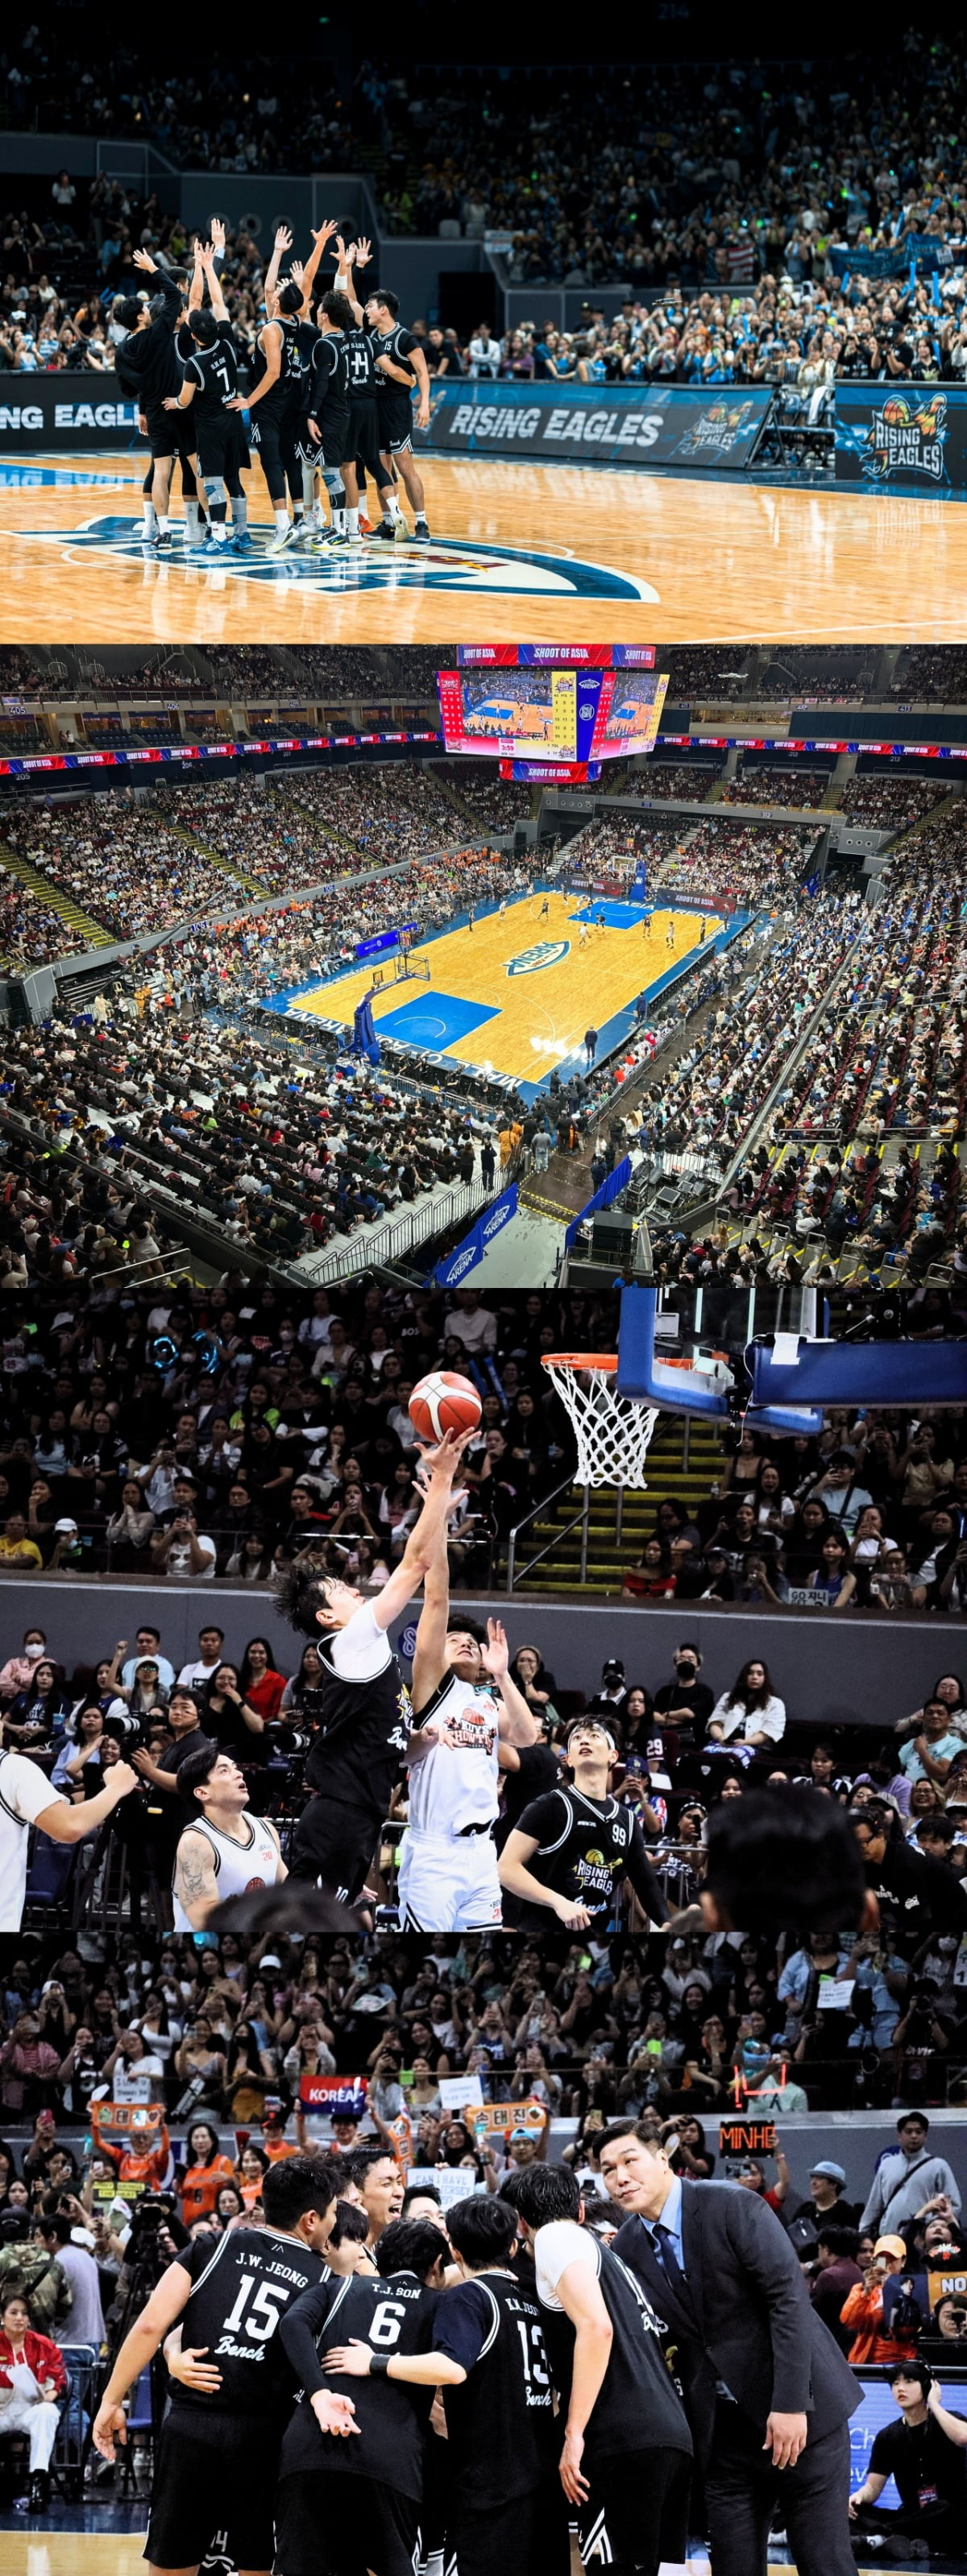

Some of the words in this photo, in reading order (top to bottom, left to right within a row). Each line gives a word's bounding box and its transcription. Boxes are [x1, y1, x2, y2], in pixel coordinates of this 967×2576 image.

[384, 341, 392, 351] 15
[216, 367, 230, 392] 7
[55, 403, 139, 428] EAGL
[449, 404, 542, 439] RISING
[542, 409, 664, 447] EAGLES
[696, 418, 728, 436] RISING
[876, 420, 920, 449] RISING
[699, 433, 736, 451] EAGLES
[889, 445, 940, 474] EAGLES
[463, 648, 475, 659] SHOOT
[476, 648, 482, 658] OF
[482, 648, 496, 658] ASIA
[534, 648, 559, 658] SHOOT
[561, 648, 570, 658] OF
[571, 648, 589, 659] ASIA
[625, 649, 641, 661] SHOOT
[641, 651, 646, 661] OF
[10, 706, 26, 714] 405
[16, 772, 31, 781] 205
[528, 768, 547, 777] SHOOT
[548, 768, 556, 777] OF
[556, 768, 571, 777] ASIA
[571, 880, 586, 888] SHOOT
[675, 895, 693, 903] SHOOT
[701, 898, 715, 906] ASIA
[661, 908, 720, 921] ARENA
[484, 1211, 507, 1238] ARENA
[448, 1253, 473, 1284] ARENA
[791, 1591, 806, 1600] GO
[645, 1738, 664, 1757] 29
[612, 1824, 627, 1846] 99
[577, 1858, 610, 1879] RISING
[309, 2087, 357, 2102] KOREA
[416, 2175, 434, 2184] CAN
[437, 2175, 440, 2184] I
[442, 2175, 467, 2185] HAVE
[235, 2252, 263, 2270] J.W.
[265, 2261, 309, 2288] JEONG
[371, 2283, 393, 2296] T.J.
[396, 2287, 422, 2299] SON
[222, 2274, 290, 2341] 15
[368, 2301, 406, 2346] 6
[214, 2335, 266, 2362] Bench
[517, 2320, 550, 2384] 13
[525, 2385, 552, 2406] Bench
